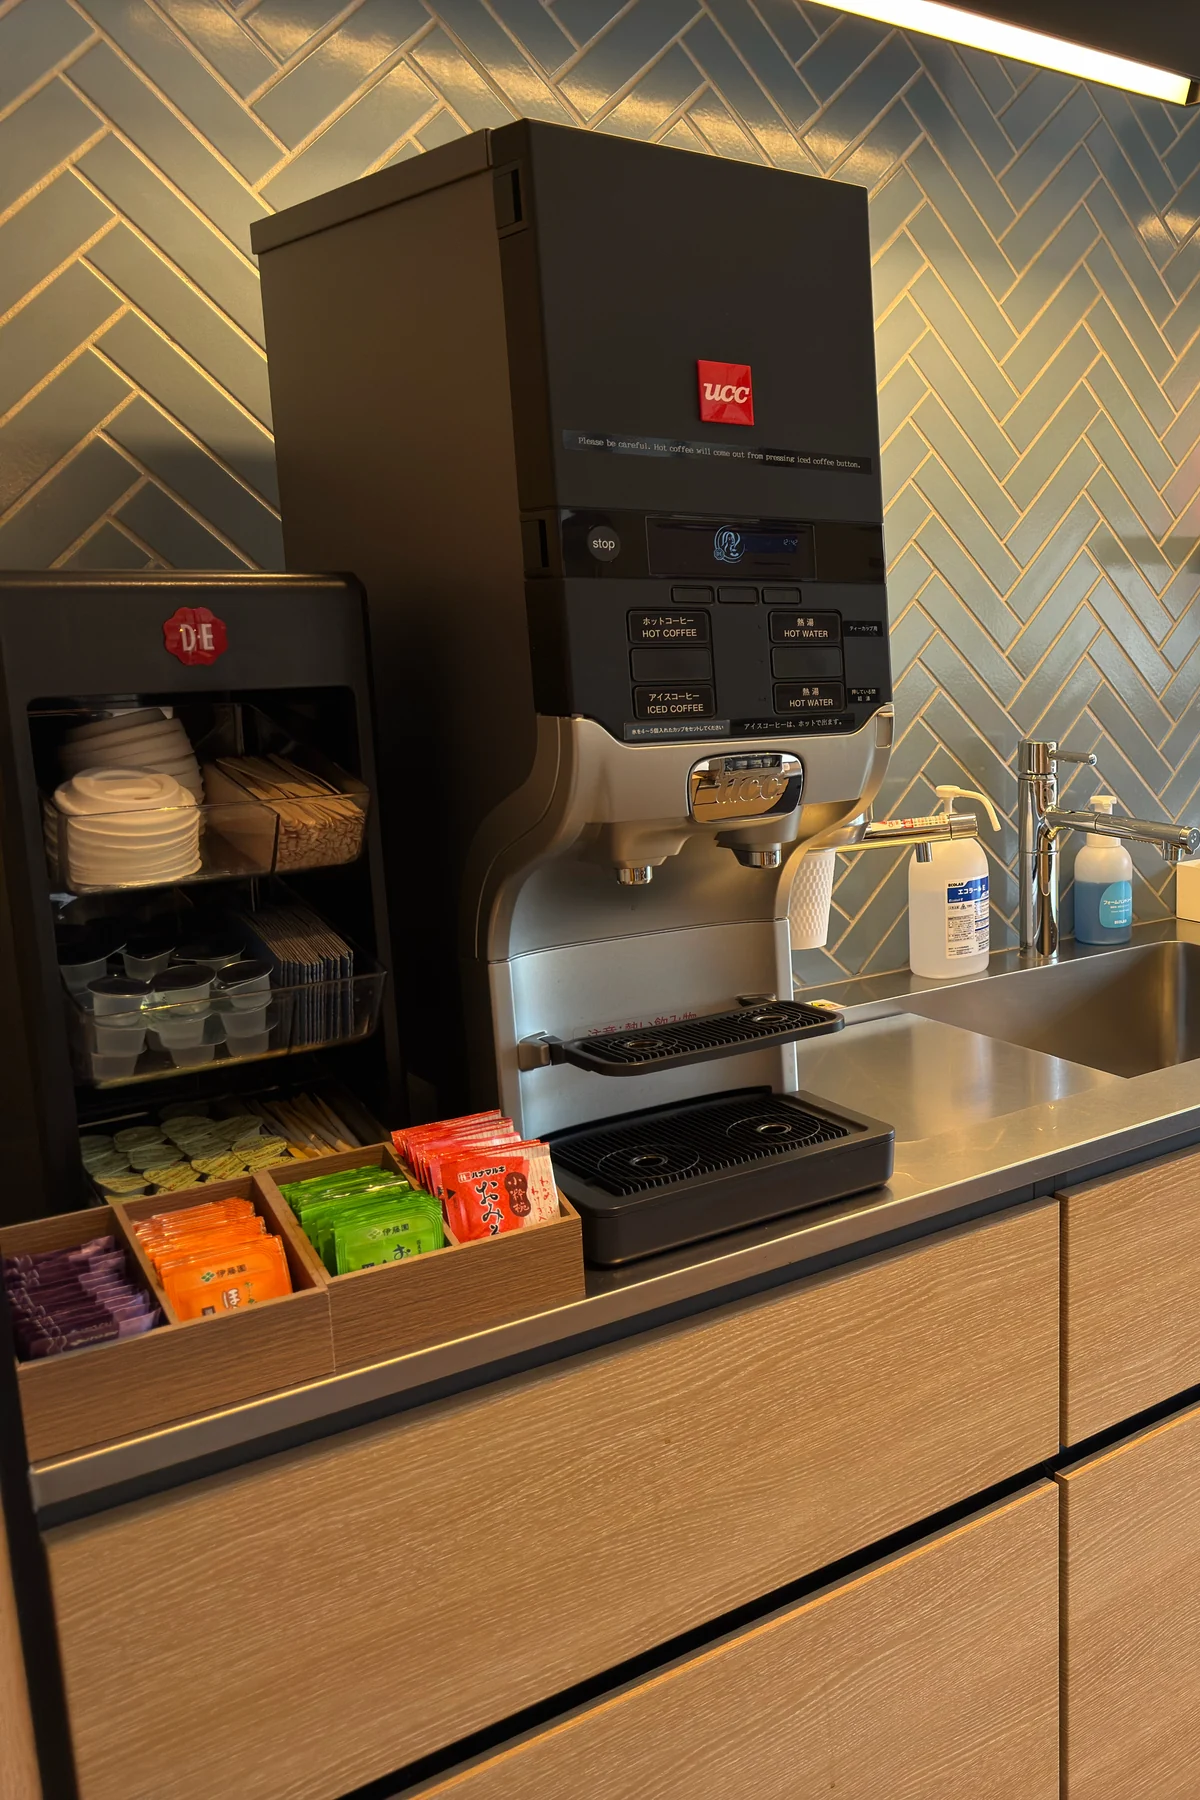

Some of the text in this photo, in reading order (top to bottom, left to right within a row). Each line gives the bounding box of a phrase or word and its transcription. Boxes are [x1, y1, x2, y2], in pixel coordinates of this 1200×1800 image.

[578, 437, 604, 446] Please
[606, 439, 616, 447] be
[618, 441, 651, 450] careful.
[654, 443, 668, 452] Hot
[669, 445, 694, 454] coffee
[747, 451, 764, 460] from
[765, 454, 795, 464] pressing
[797, 455, 811, 464] iced
[812, 457, 835, 466] coffee
[836, 459, 861, 469] button.
[592, 538, 615, 551] stop
[643, 617, 694, 626] ホットコーヒー
[642, 628, 697, 638] HOT COFFEE
[784, 629, 829, 638] HOT WATER
[649, 692, 700, 702] アイスコーヒー
[647, 703, 704, 714] ICED COFFEE
[789, 698, 834, 708] HOT WATER
[471, 1166, 506, 1178] ハナマルキ
[382, 1223, 409, 1236] 伊藤園
[216, 1264, 247, 1277] 伊藤園
